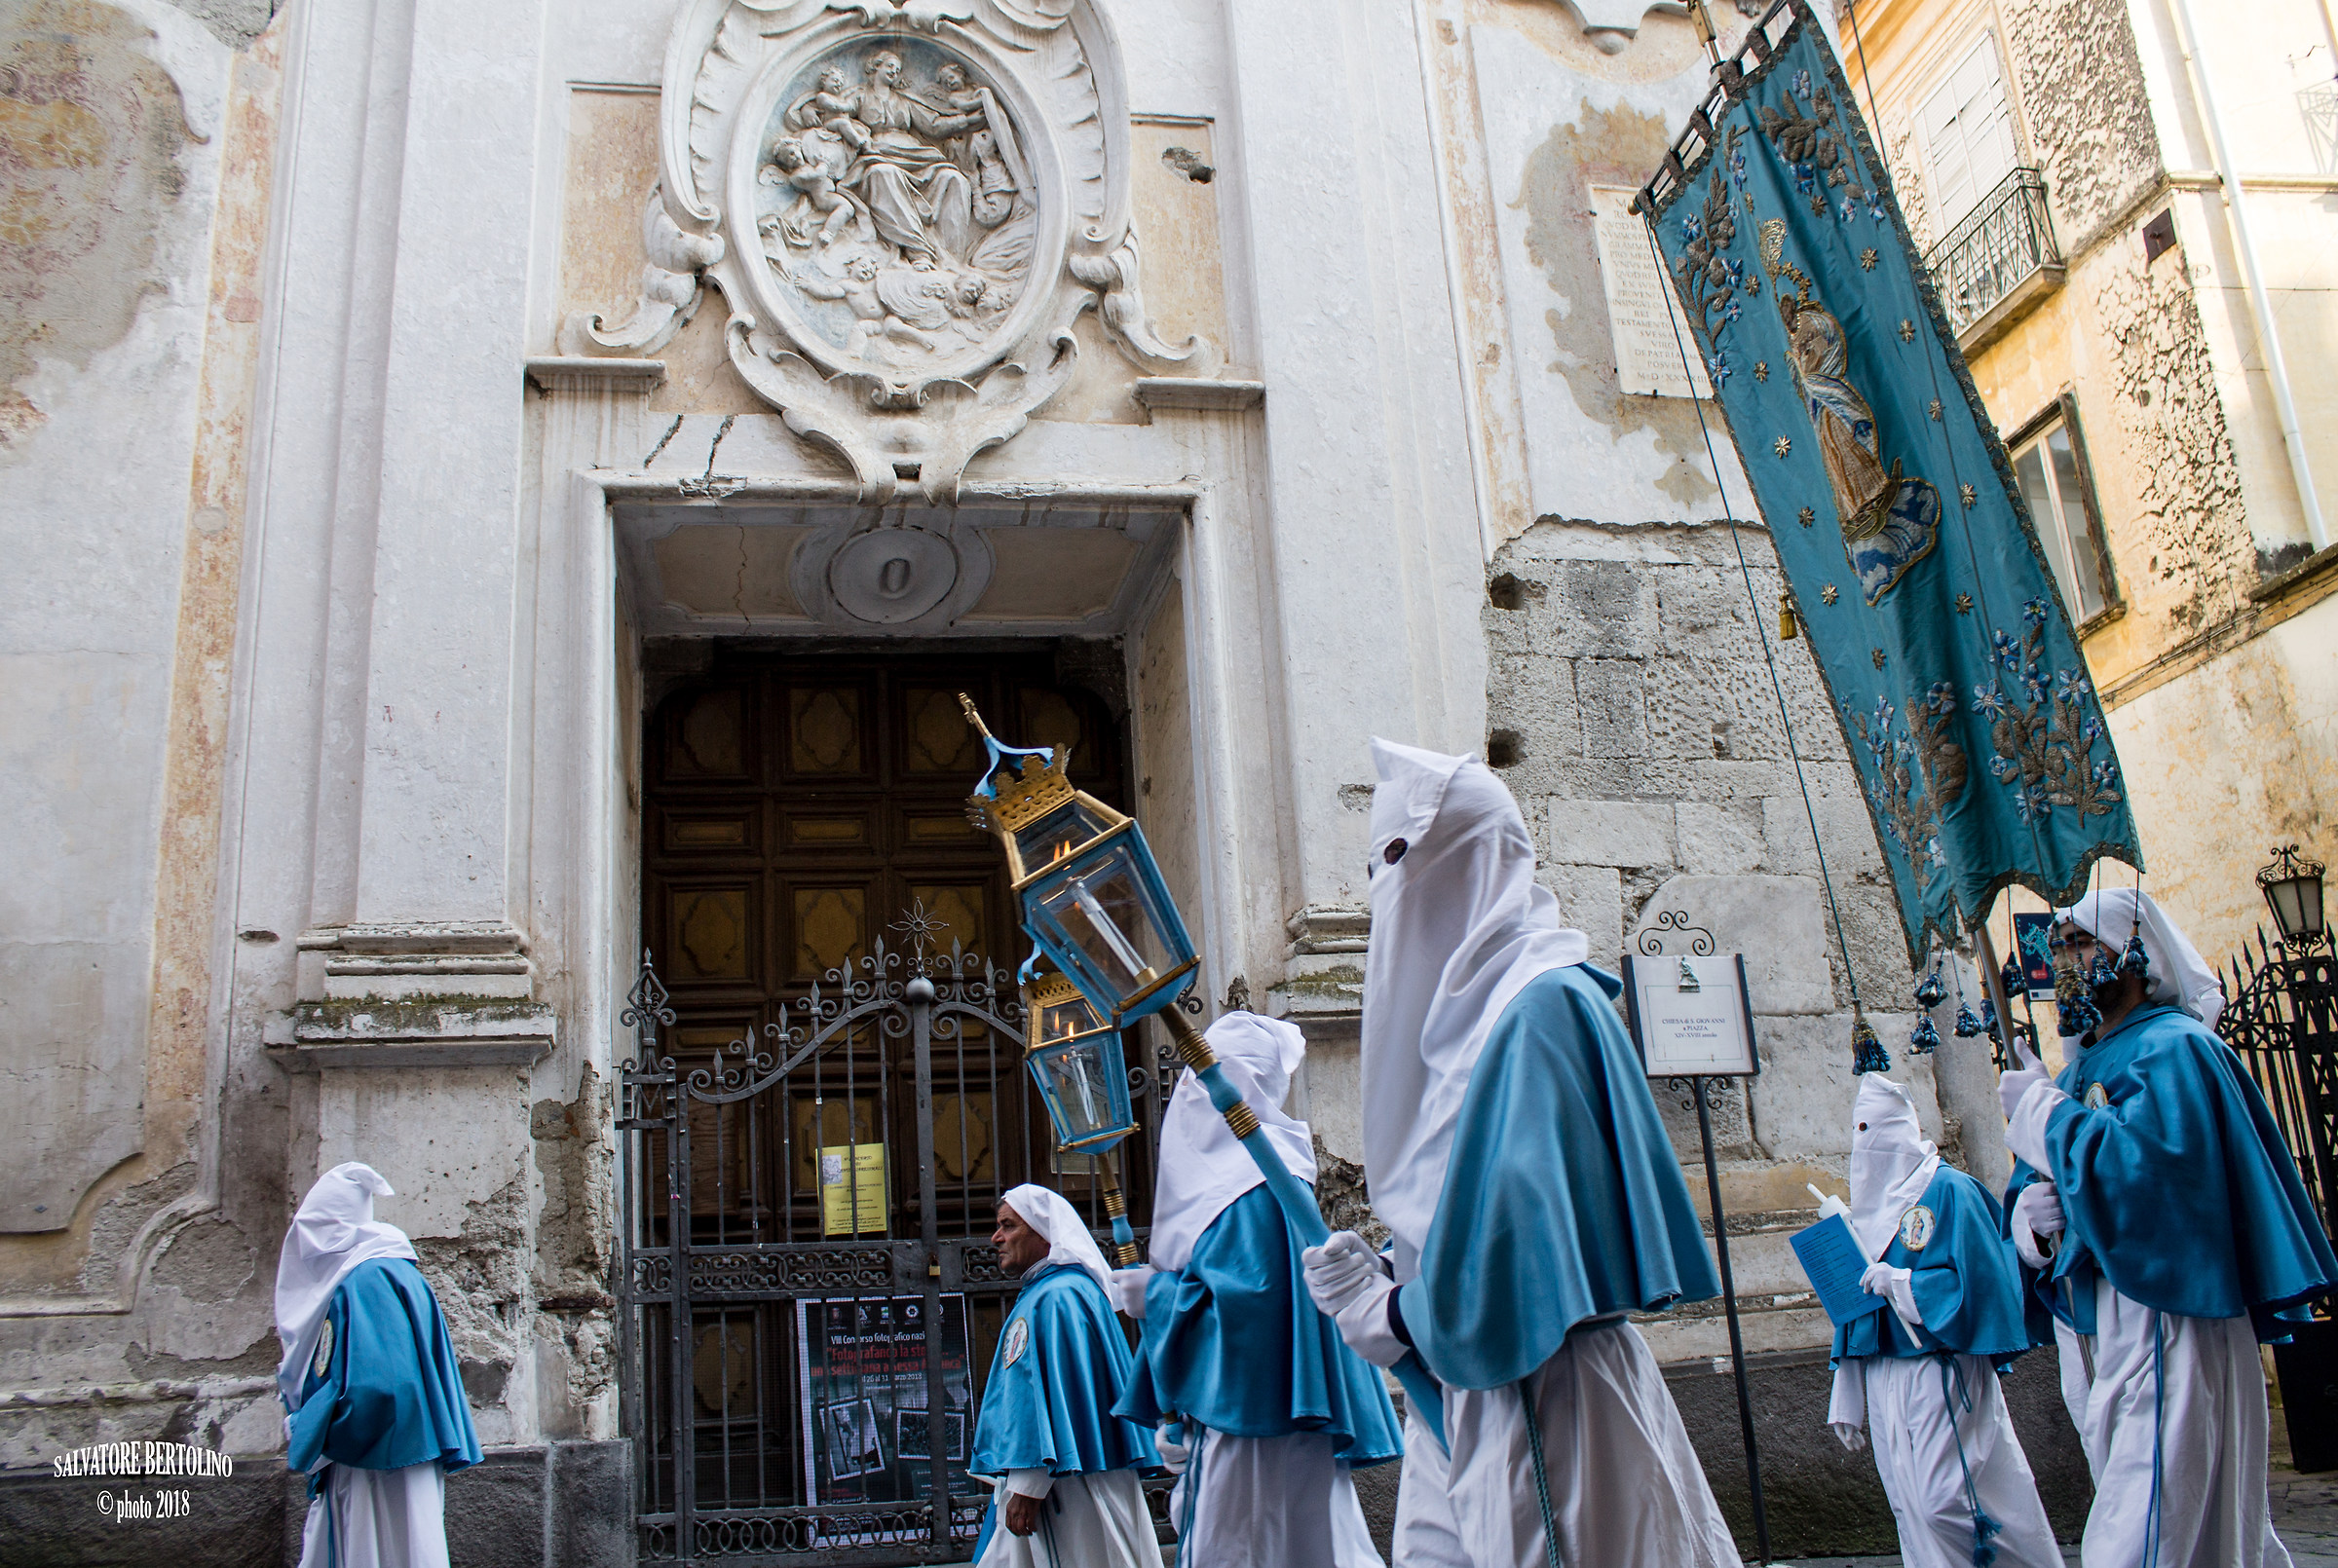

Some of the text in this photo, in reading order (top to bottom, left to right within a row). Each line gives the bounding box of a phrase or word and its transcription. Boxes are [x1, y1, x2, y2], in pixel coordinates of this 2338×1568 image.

[1640, 330, 1684, 341] SVESSAI
[1650, 340, 1675, 350] VIRO
[843, 1334, 873, 1344] Conorso
[830, 1362, 881, 1376] settiana
[891, 1360, 919, 1372] essa
